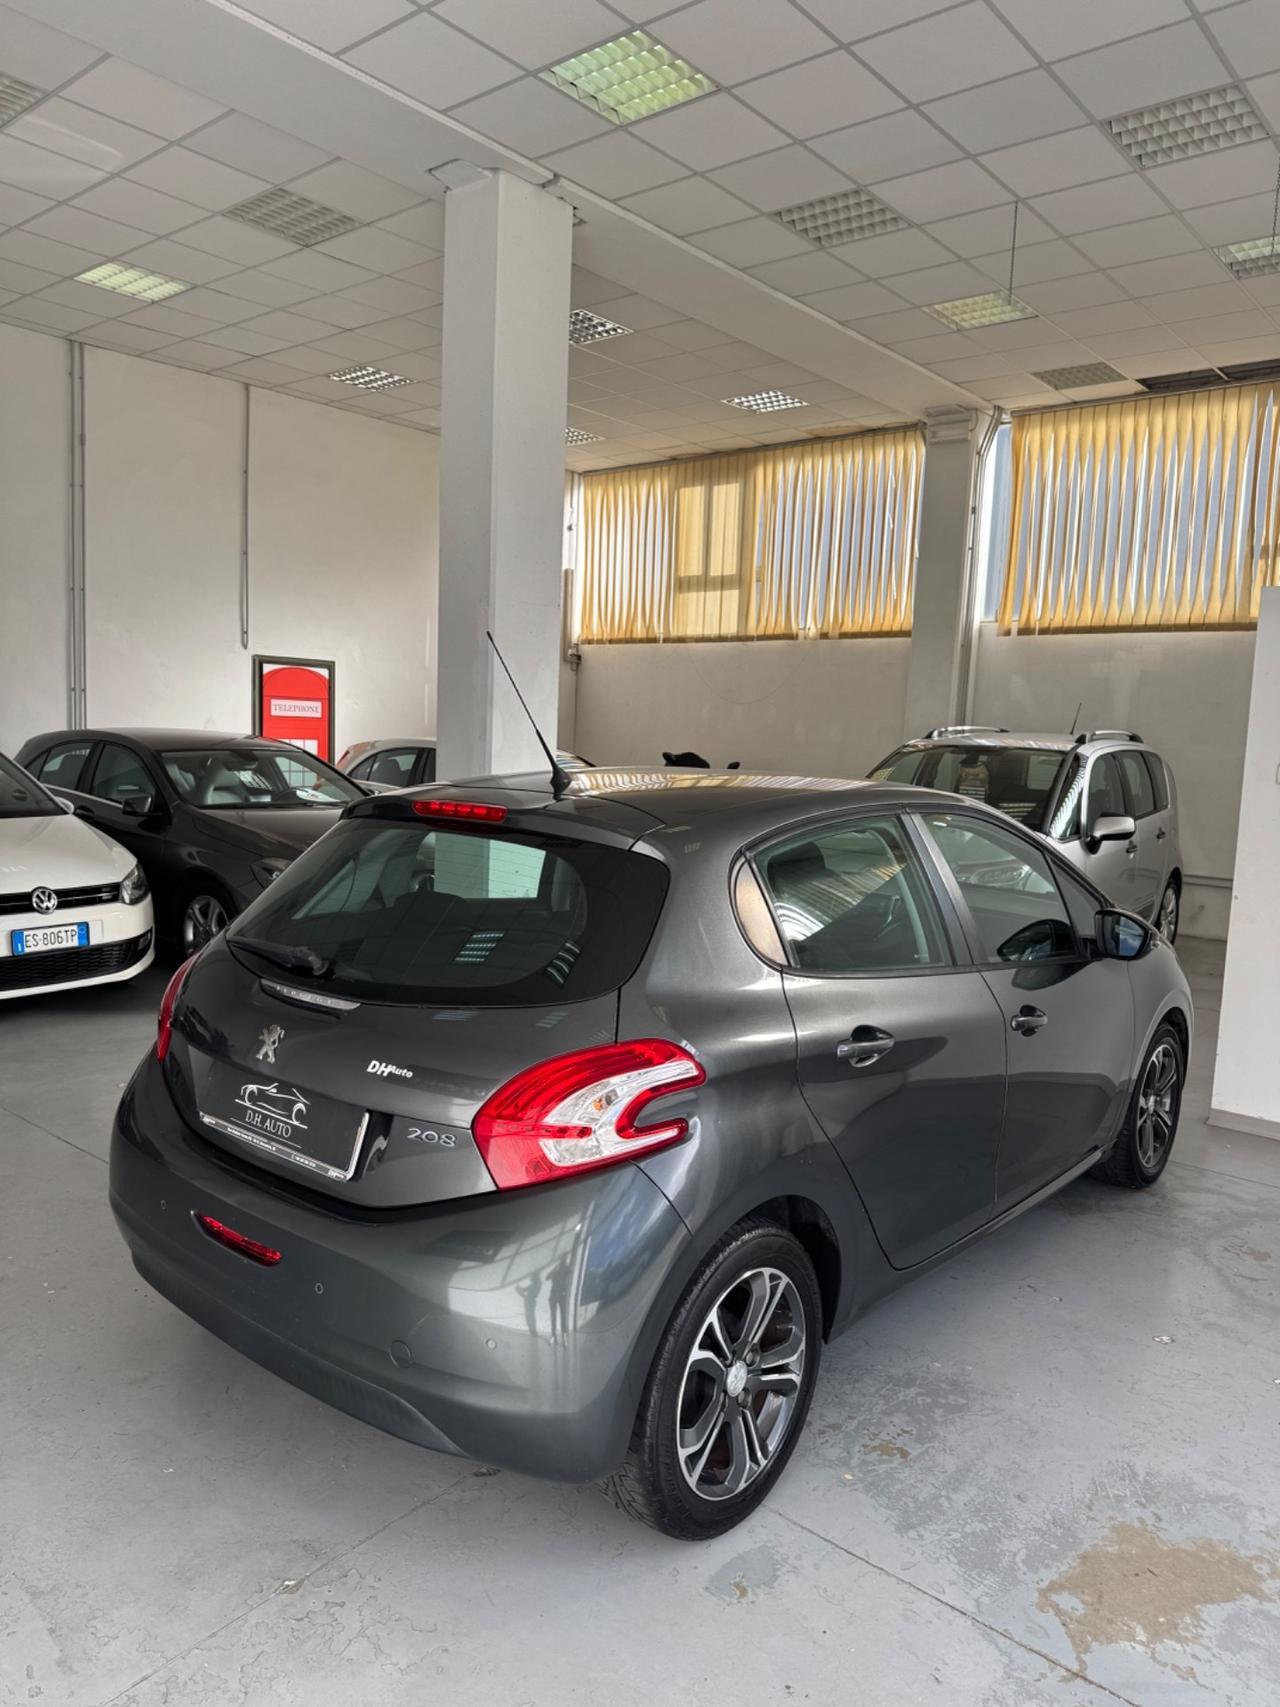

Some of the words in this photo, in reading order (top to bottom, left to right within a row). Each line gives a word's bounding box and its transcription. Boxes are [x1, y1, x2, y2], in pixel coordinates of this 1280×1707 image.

[272, 703, 320, 714] TELEPHONE
[263, 1117, 291, 1137] AUTO
[407, 1127, 456, 1147] 208
